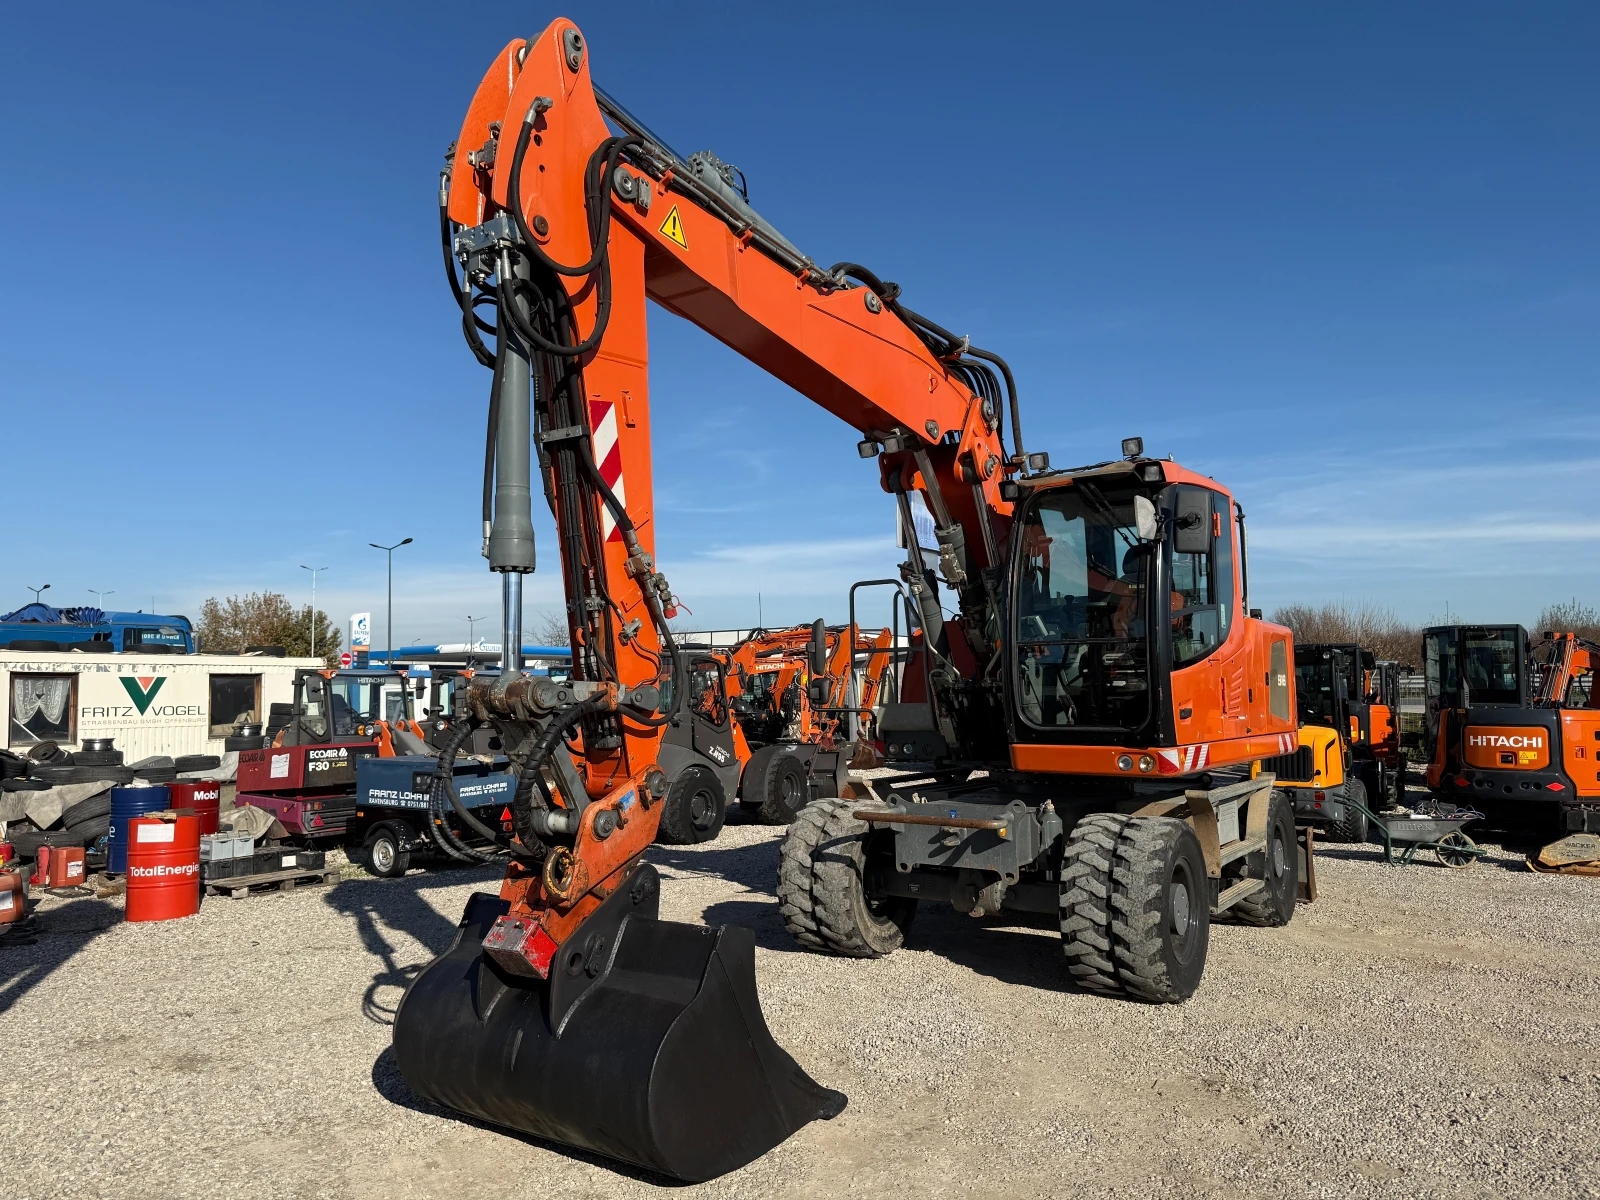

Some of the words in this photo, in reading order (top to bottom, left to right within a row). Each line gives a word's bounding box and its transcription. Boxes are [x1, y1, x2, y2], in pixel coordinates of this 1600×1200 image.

[755, 662, 785, 670] HITACHI
[81, 706, 133, 718] FRITZ
[152, 705, 206, 716] VOGEL
[1469, 735, 1543, 748] HITACHI
[309, 749, 338, 759] ECOAIR
[308, 761, 330, 772] F30
[193, 789, 219, 801] Mobil
[368, 789, 398, 799] FRANZ
[399, 791, 423, 801] LOHR
